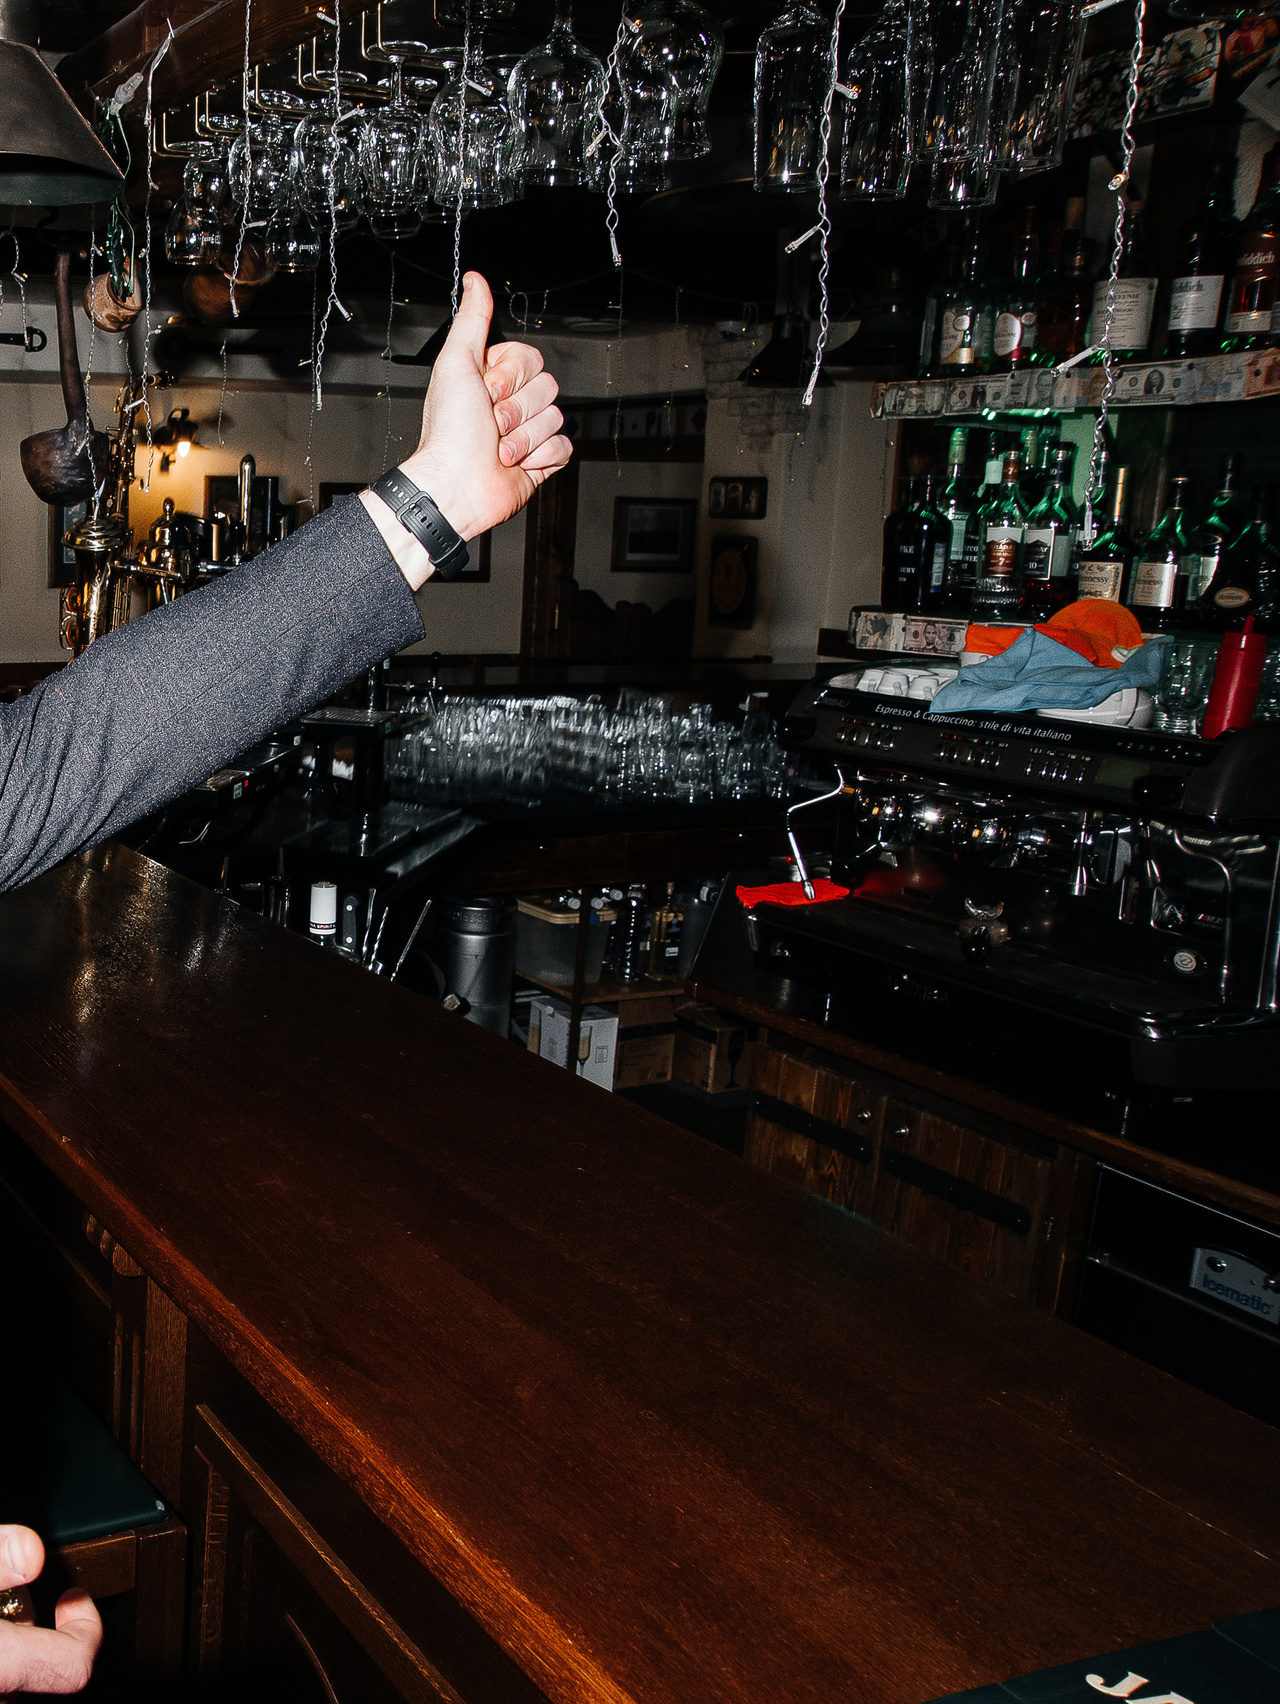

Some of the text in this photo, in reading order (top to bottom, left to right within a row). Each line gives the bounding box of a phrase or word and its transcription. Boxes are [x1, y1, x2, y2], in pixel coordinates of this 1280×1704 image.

[1028, 561, 1038, 569] 10
[875, 703, 1072, 742] Espresso & Cappuccino: stile di vita italiano
